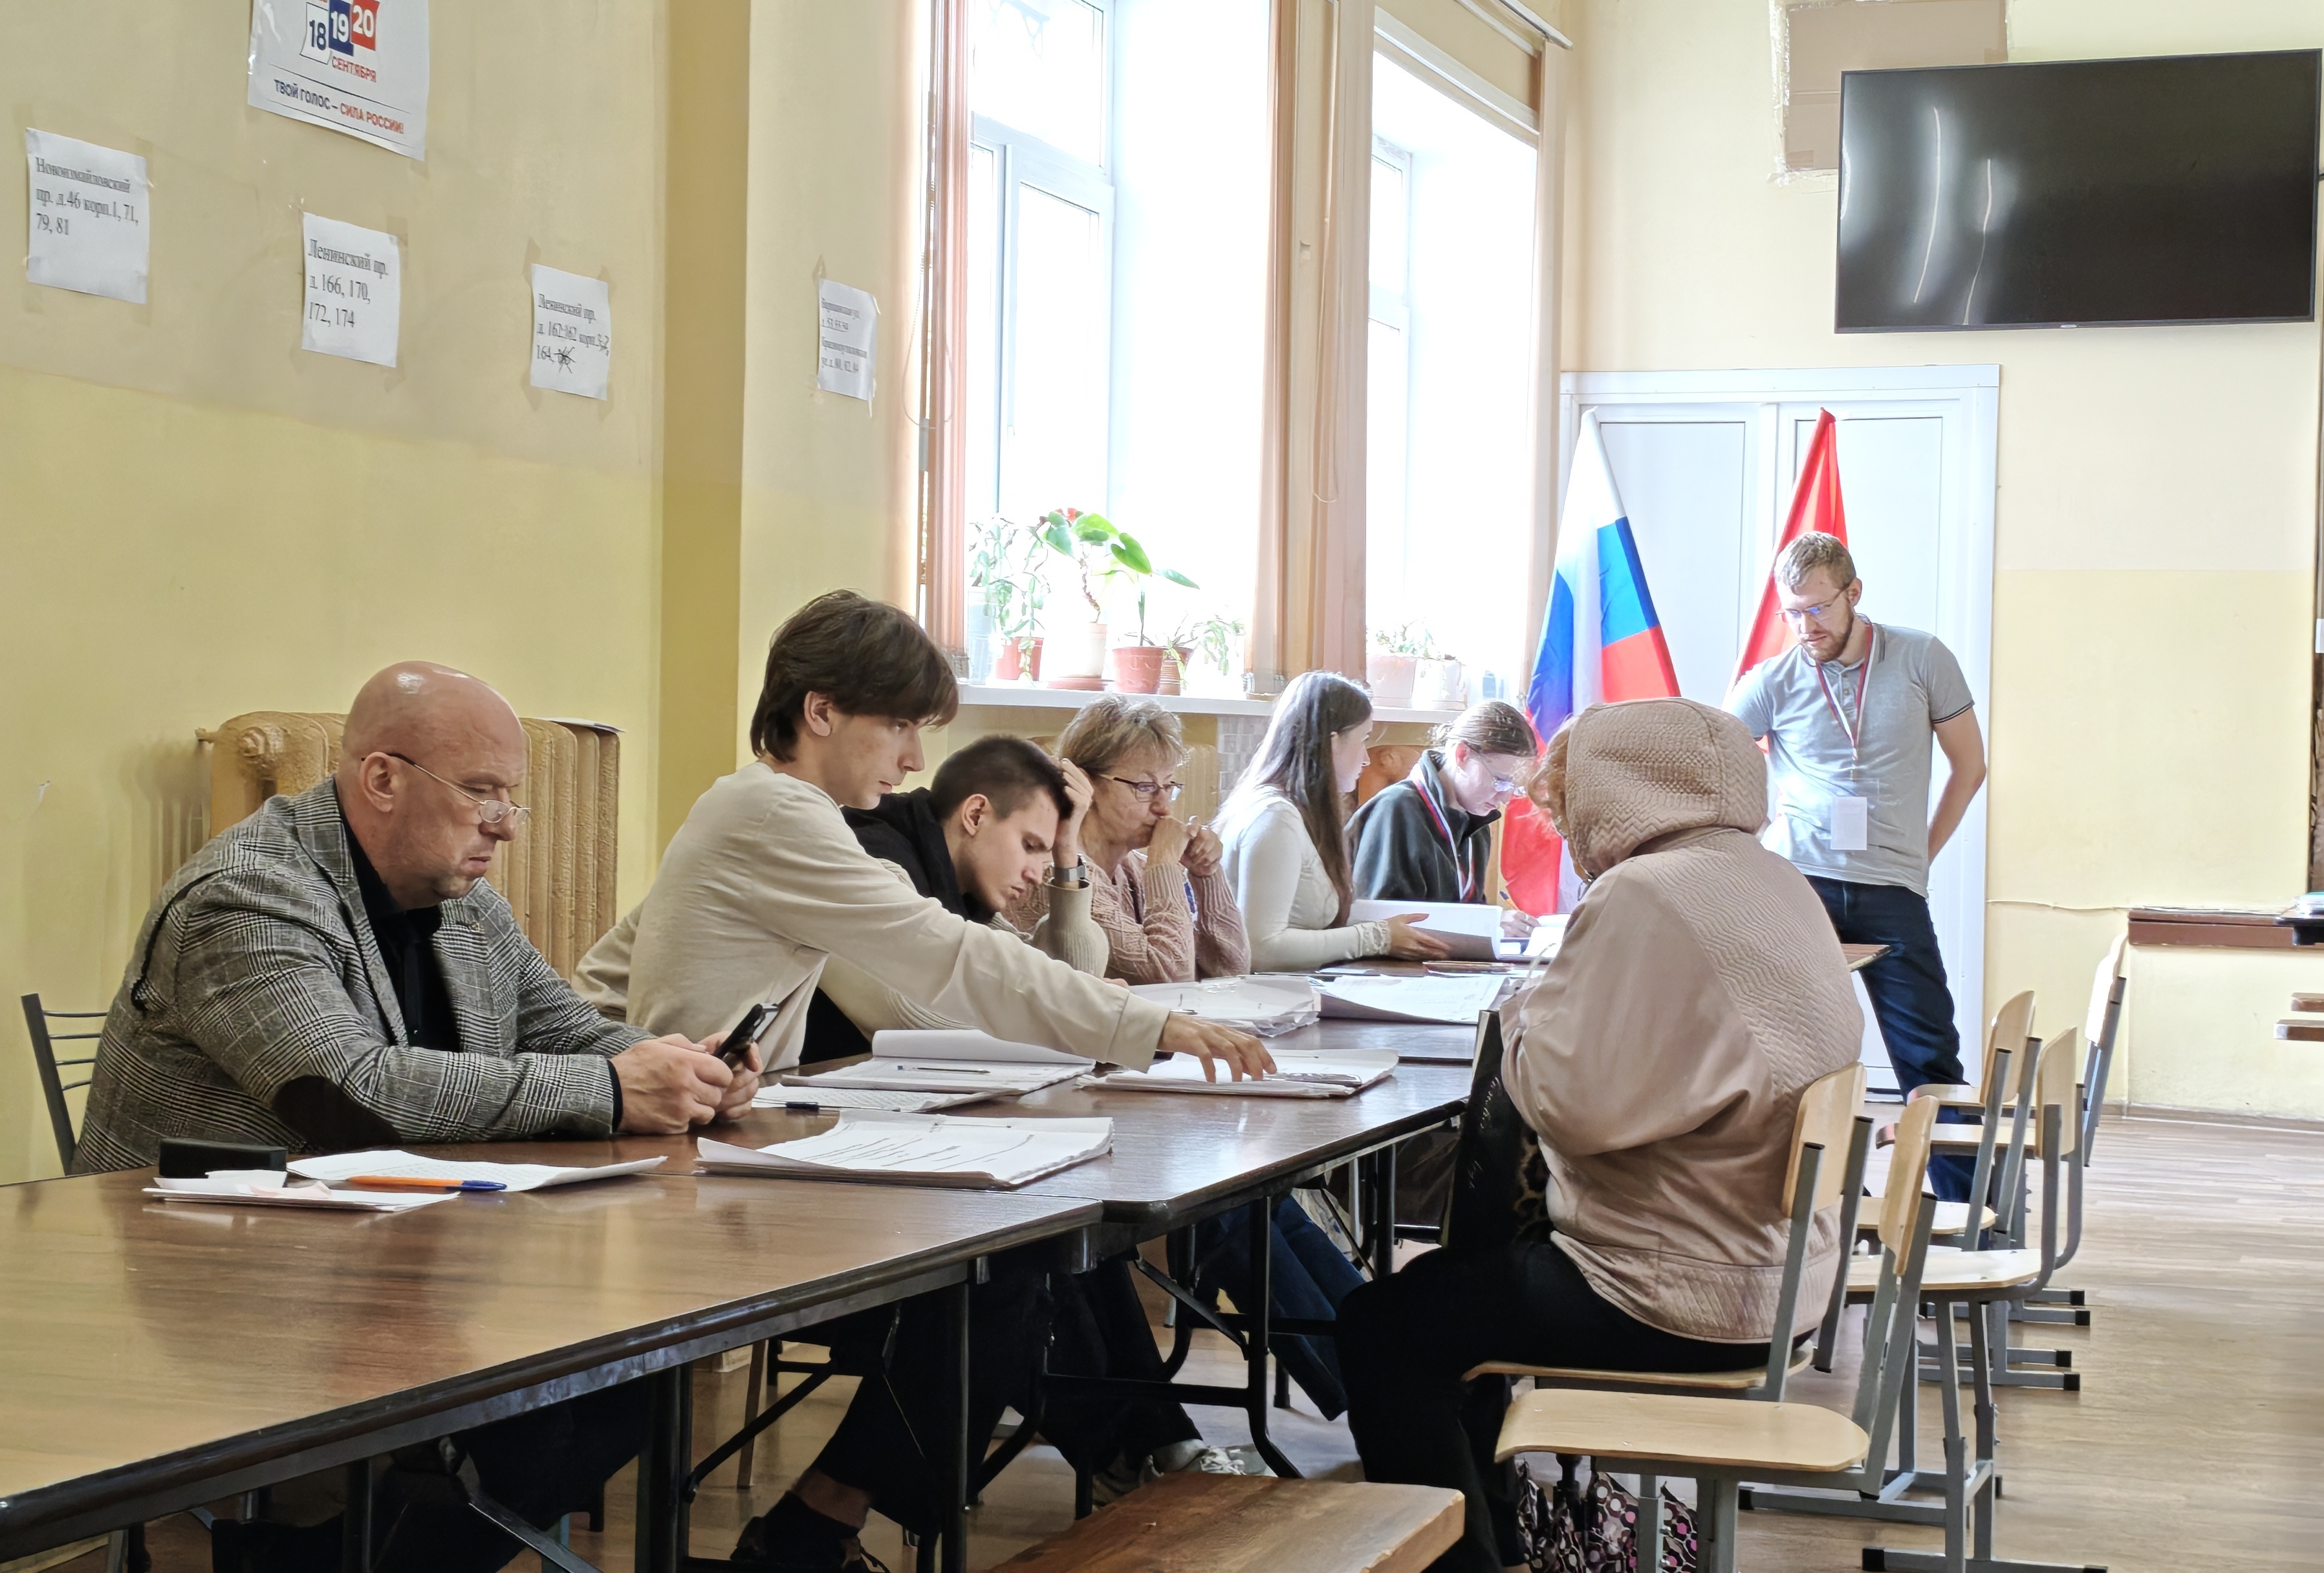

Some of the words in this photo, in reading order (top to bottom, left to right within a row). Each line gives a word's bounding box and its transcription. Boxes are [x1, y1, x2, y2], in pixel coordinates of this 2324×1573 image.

[309, 19, 327, 50] 18
[331, 10, 349, 43] 19
[353, 5, 375, 38] 20
[332, 56, 376, 83] СЕНТЯБРЯ
[274, 78, 298, 100] ТВОЙ
[301, 90, 331, 110] ГОЛОС
[340, 103, 364, 122] СИЛА
[56, 217, 69, 235] 81
[336, 308, 356, 328] 174
